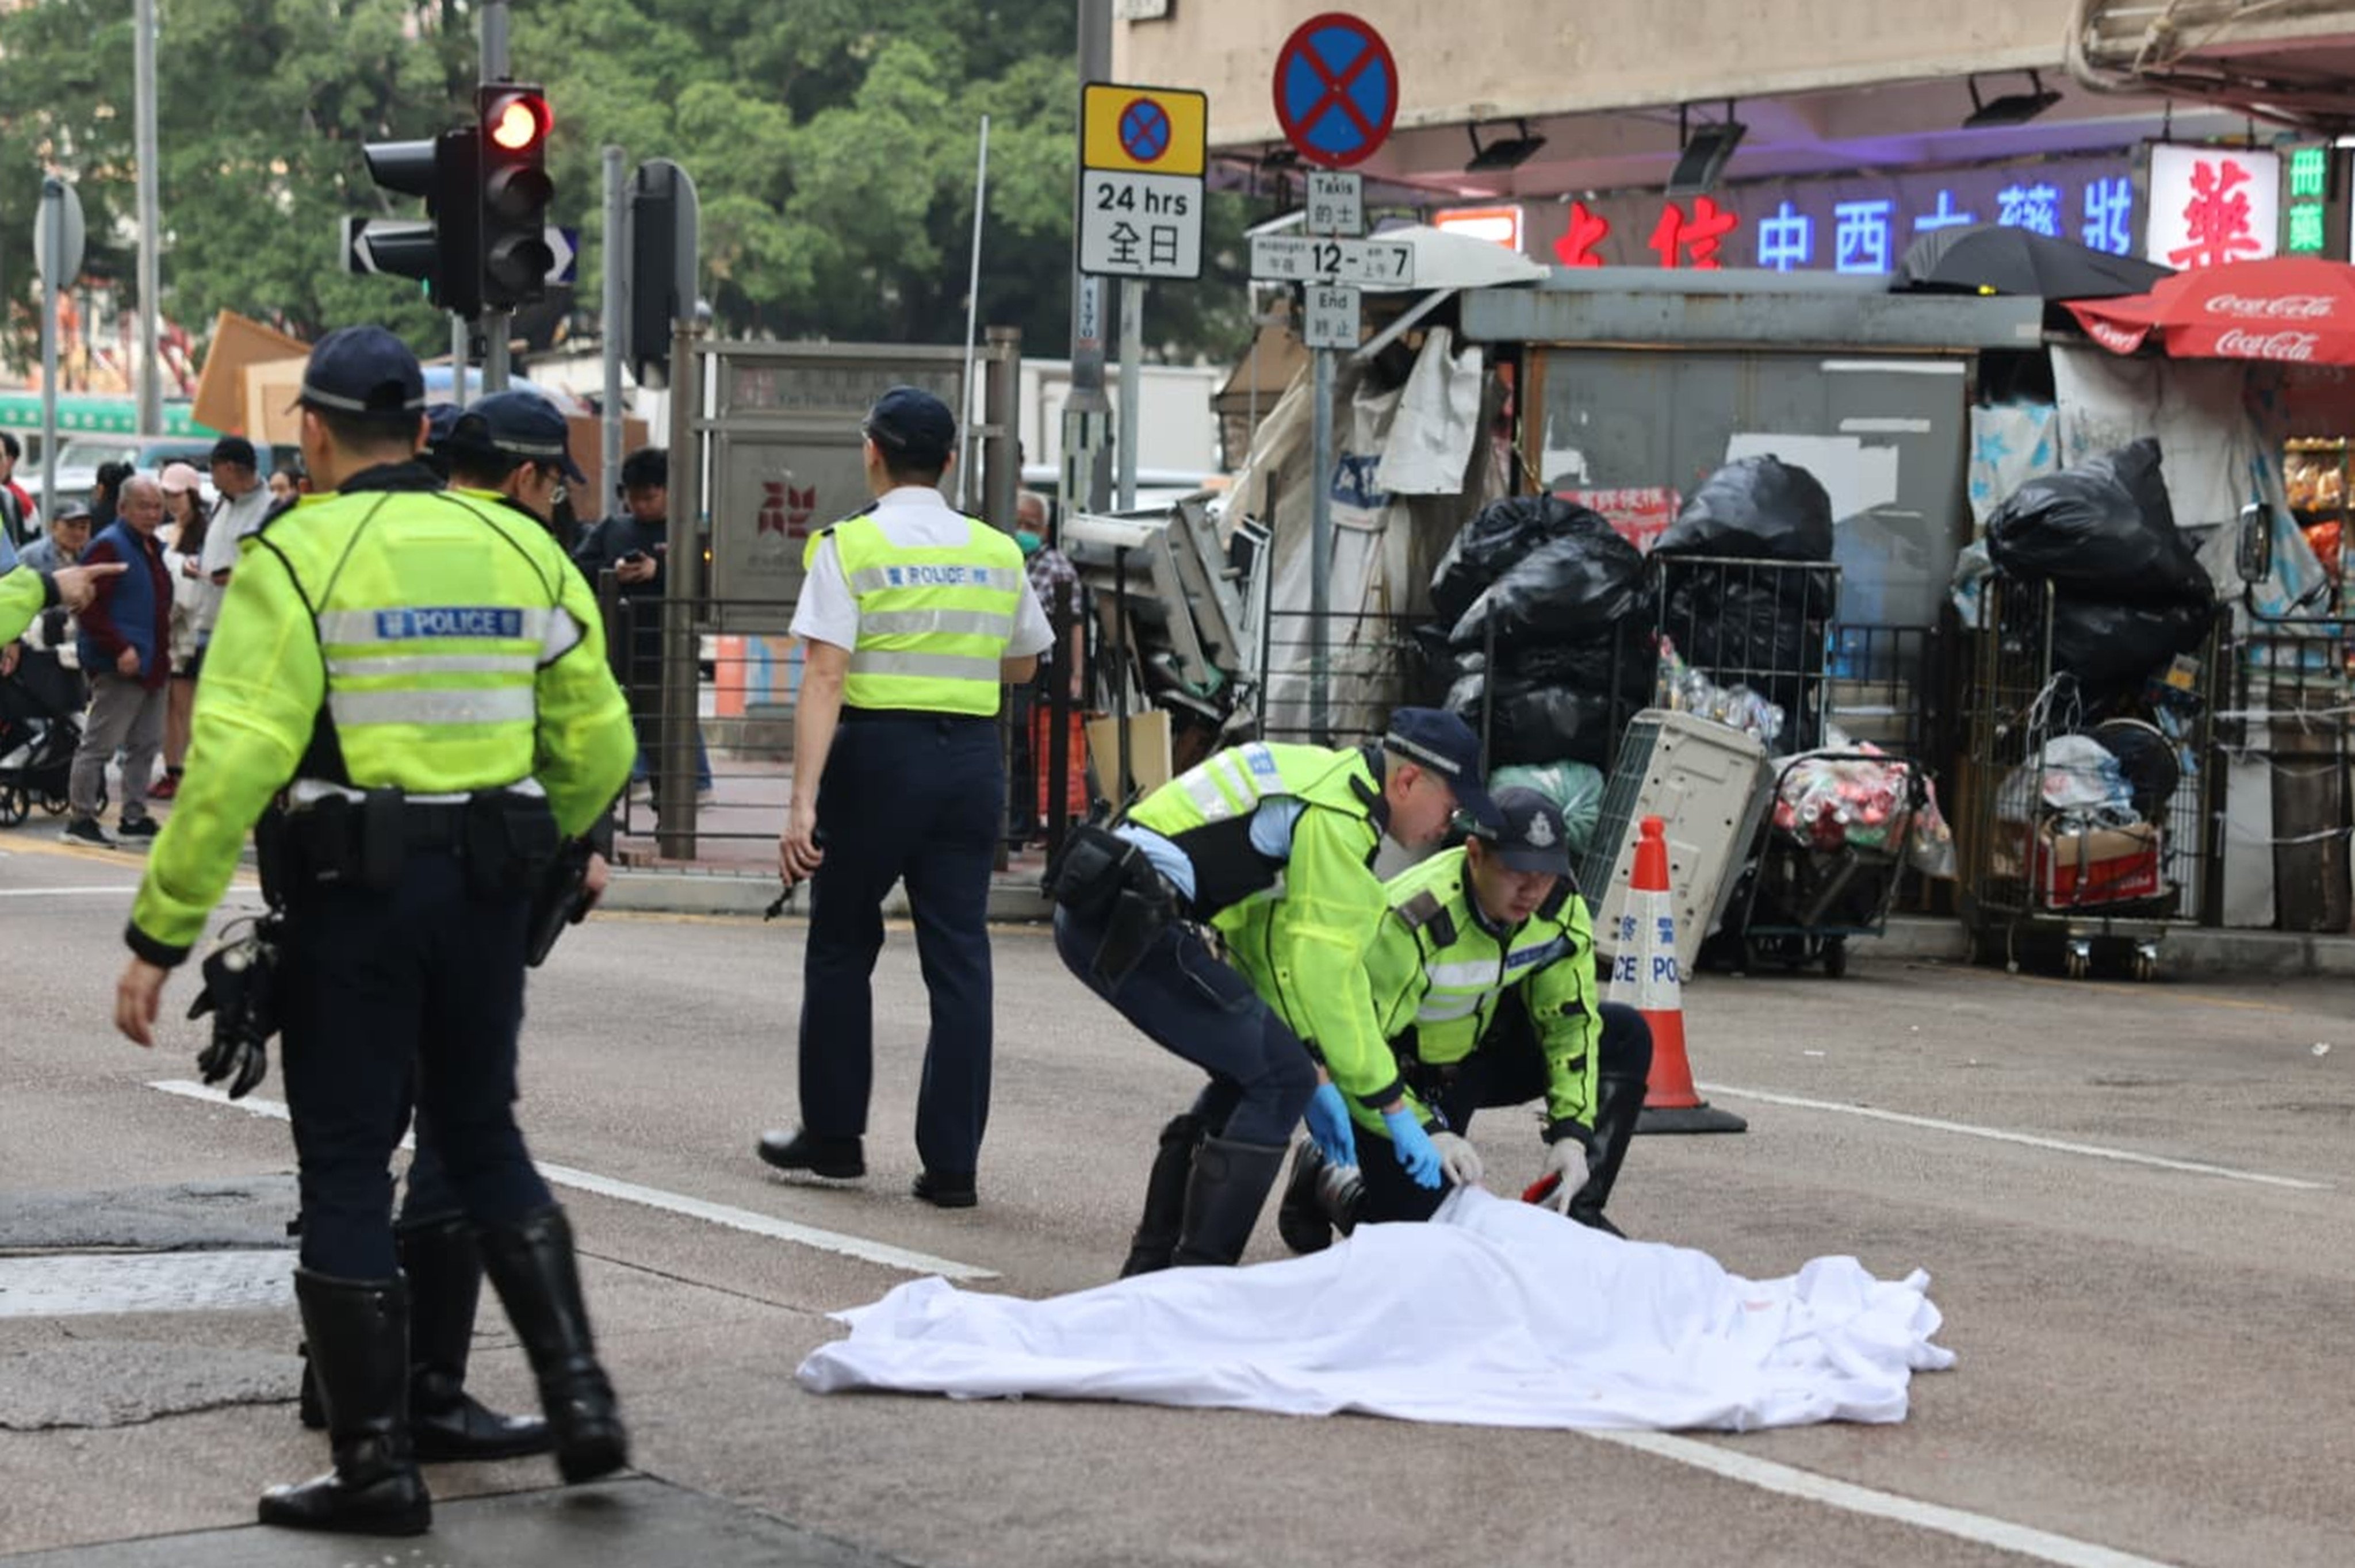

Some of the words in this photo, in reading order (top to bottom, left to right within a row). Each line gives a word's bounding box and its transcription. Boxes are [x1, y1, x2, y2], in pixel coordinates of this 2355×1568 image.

[1315, 178, 1354, 195] Taxis
[1098, 183, 1135, 212] 24
[1145, 186, 1188, 216] hrs
[1315, 205, 1352, 224] 的士
[1107, 221, 1178, 266] 全日
[1392, 248, 1407, 277] 7
[1319, 292, 1347, 309] End
[2204, 294, 2337, 317] Coca-Cola
[2215, 328, 2319, 359] Coca-Cola
[909, 566, 965, 584] POLICE
[413, 610, 496, 633] POLICE
